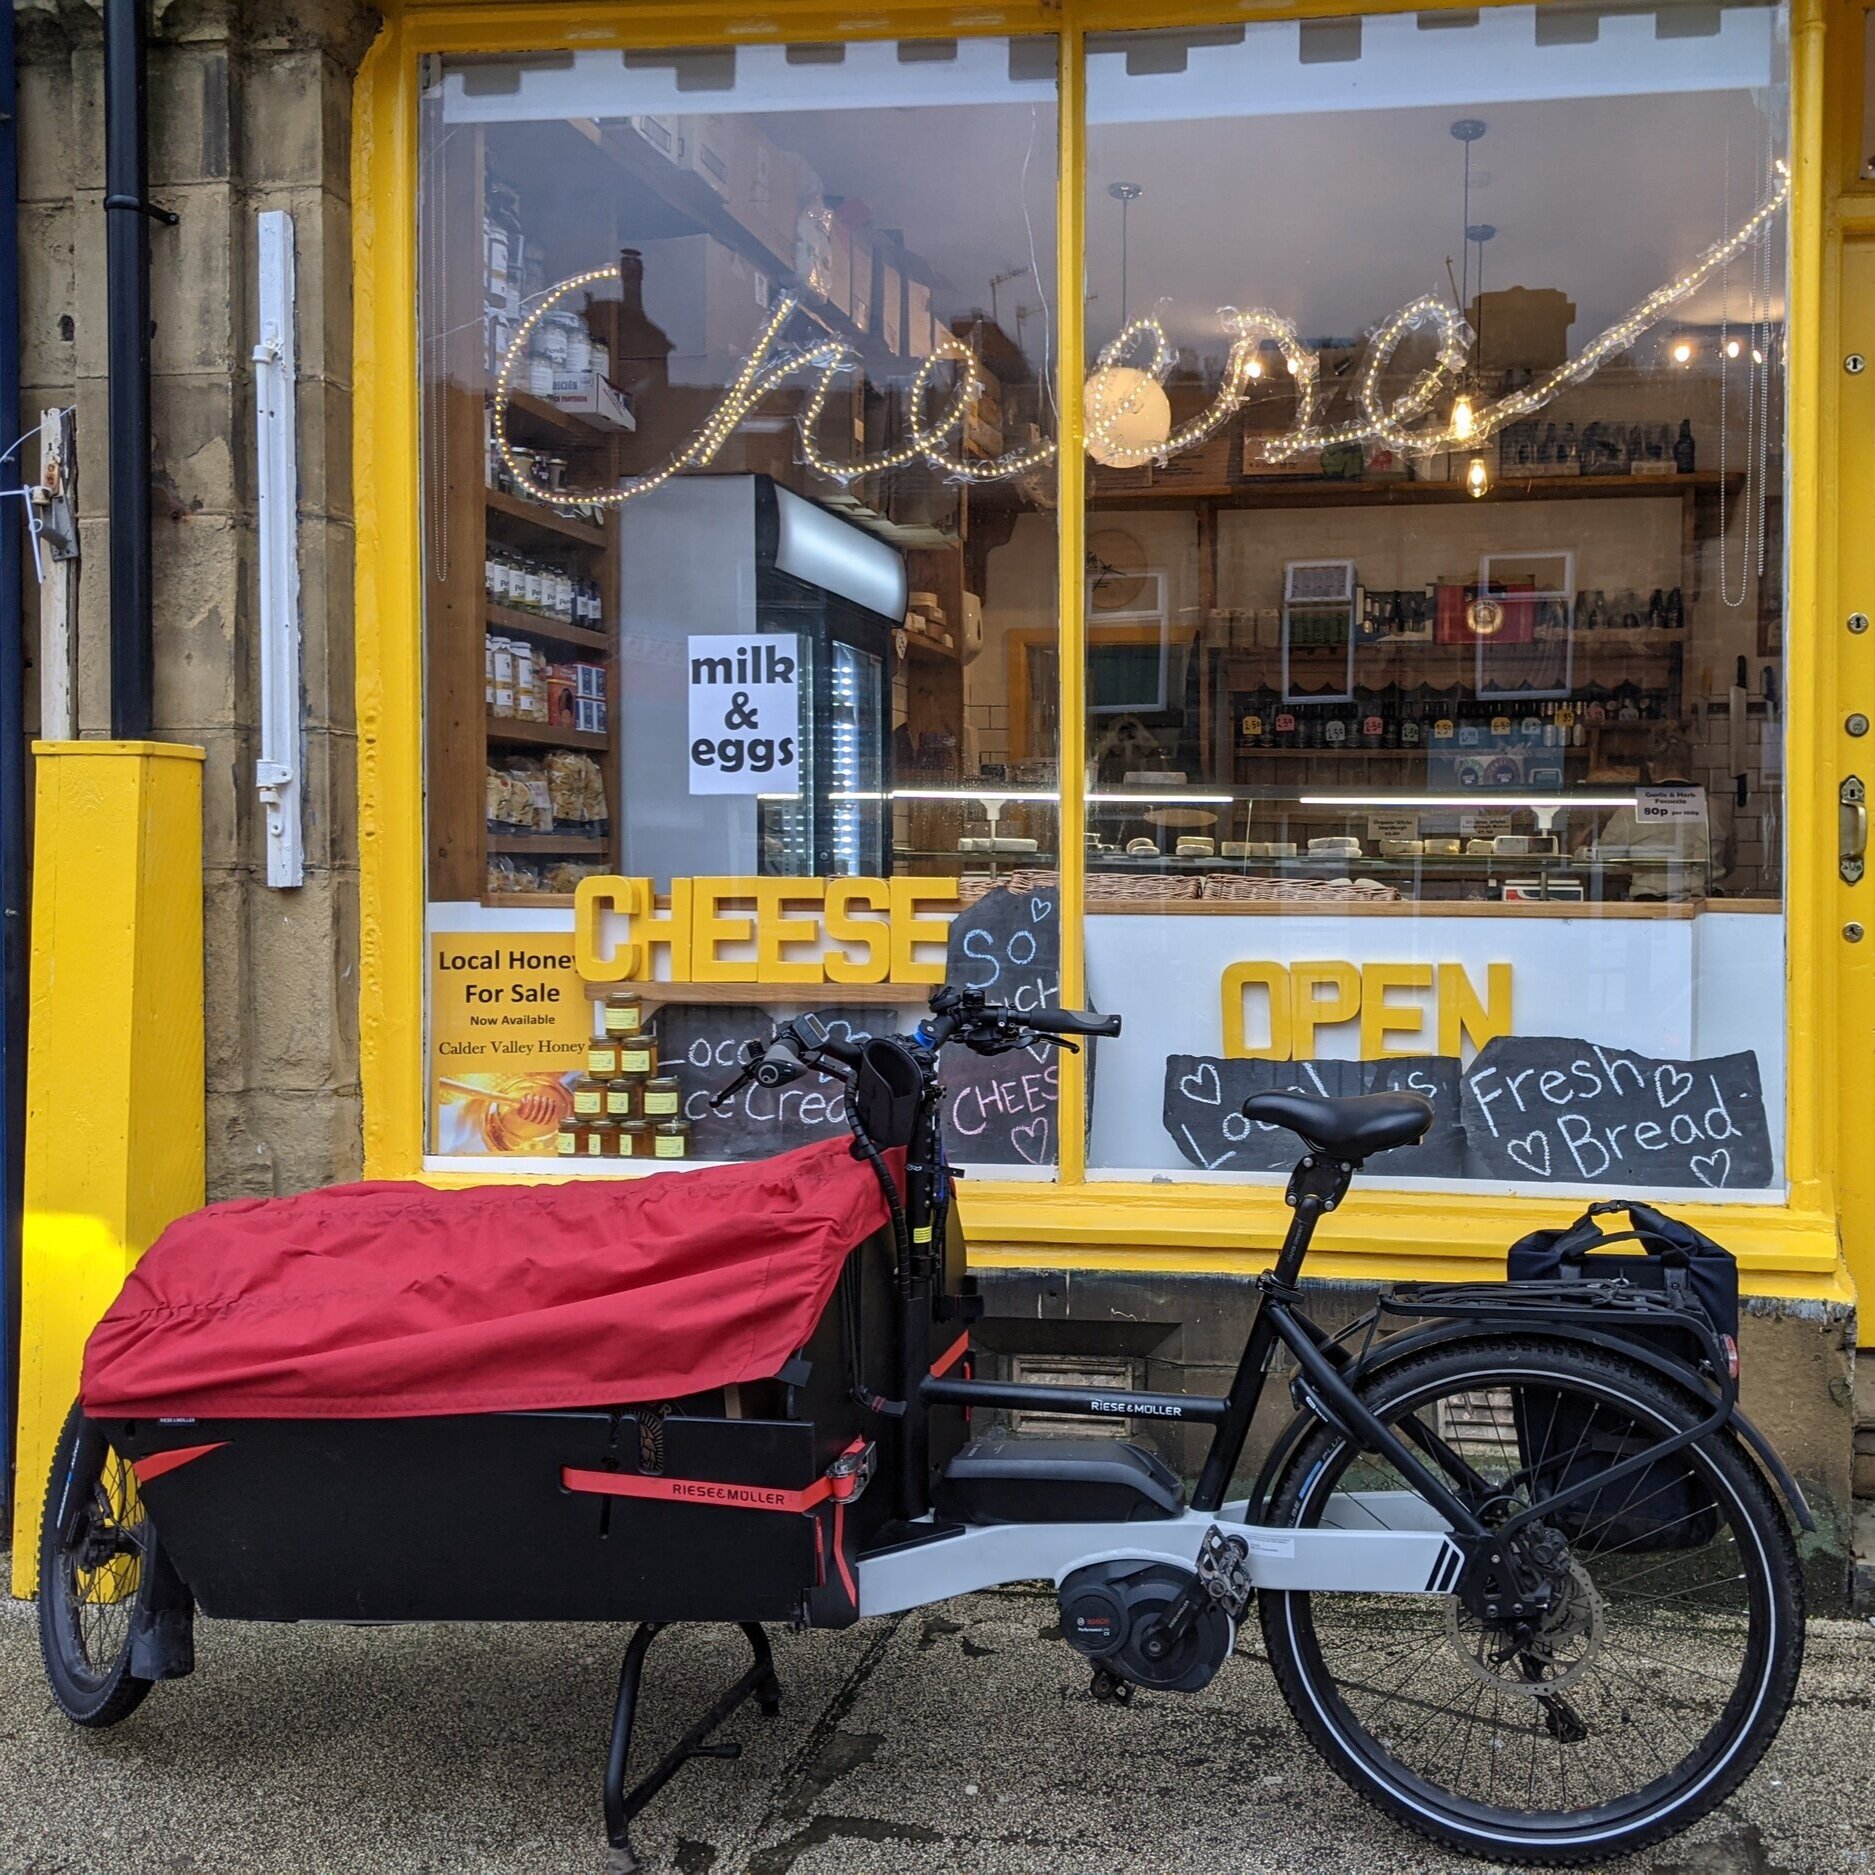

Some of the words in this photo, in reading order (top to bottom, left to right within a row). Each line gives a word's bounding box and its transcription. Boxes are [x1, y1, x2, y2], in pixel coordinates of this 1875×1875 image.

[691, 645, 795, 685] milk
[724, 691, 759, 731] &
[691, 737, 795, 773] eggs
[1644, 807, 1668, 817] 80p
[574, 875, 959, 985] CHEESE
[439, 950, 500, 971] Local
[963, 929, 1037, 989] SO
[465, 985, 505, 1004] For
[511, 983, 560, 1003] Sale
[1221, 960, 1512, 1062] OPEN
[470, 1015, 498, 1026] Now
[501, 1015, 556, 1025] Available
[439, 1041, 486, 1056] Calder
[490, 1040, 534, 1056] Valley
[538, 1040, 586, 1055] Honey
[1469, 1046, 1644, 1138] Fresh
[1558, 1075, 1742, 1179] Bread
[672, 1483, 785, 1506] RIESE&MÜLLER
